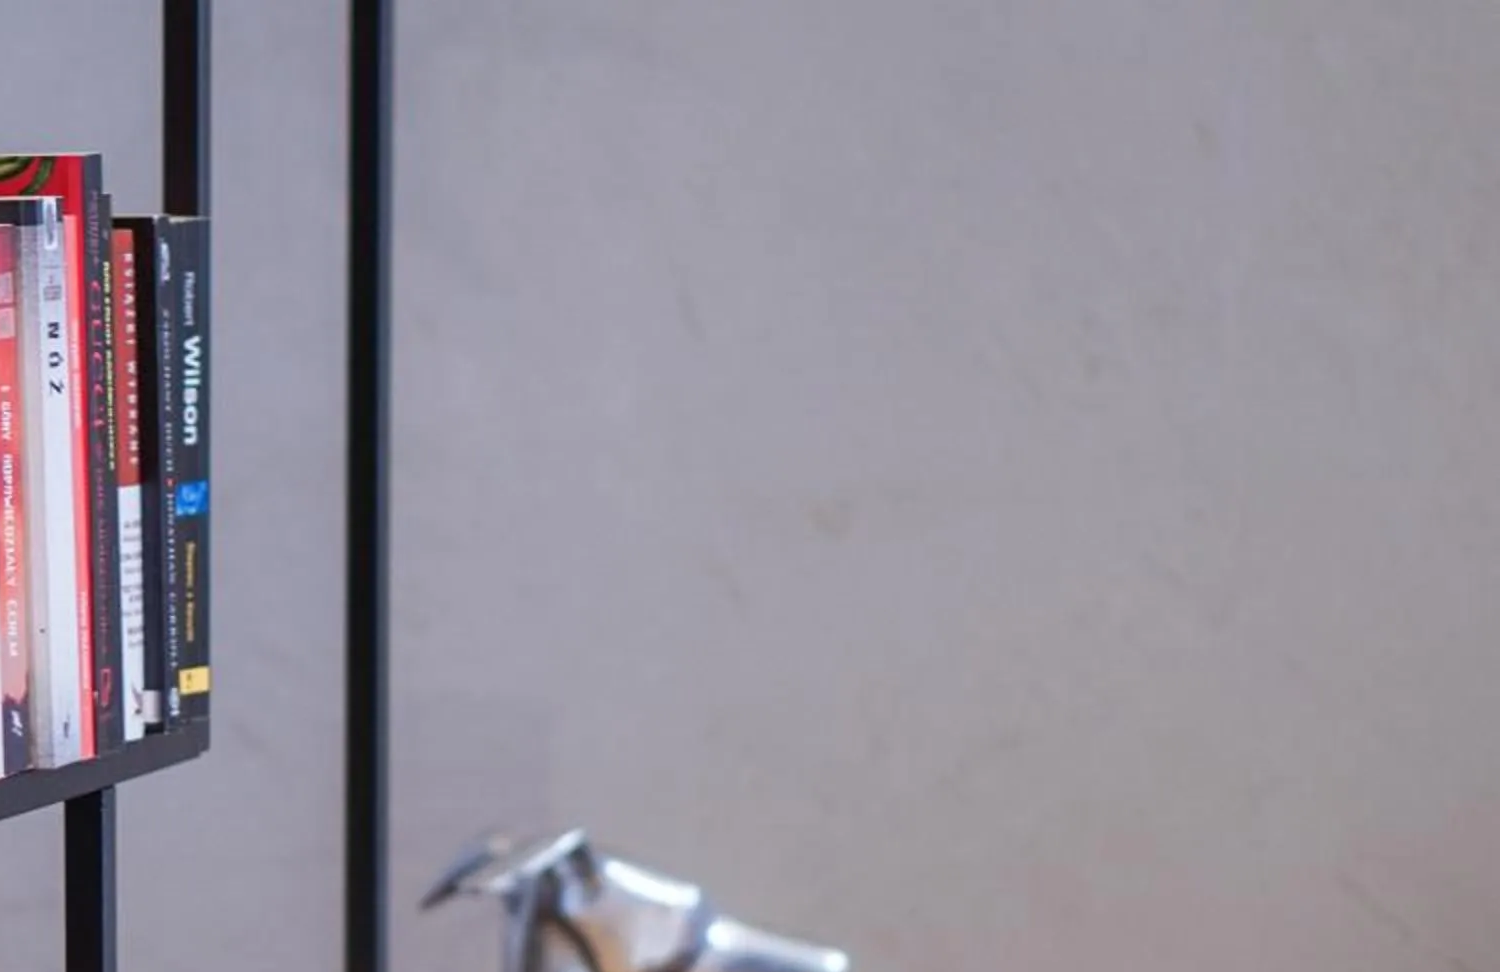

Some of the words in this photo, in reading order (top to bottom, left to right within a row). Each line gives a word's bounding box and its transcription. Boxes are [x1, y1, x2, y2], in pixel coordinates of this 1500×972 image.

[126, 360, 140, 466] WYBRANE
[183, 335, 202, 446] Wilson
[165, 492, 177, 584] JONATHAN
